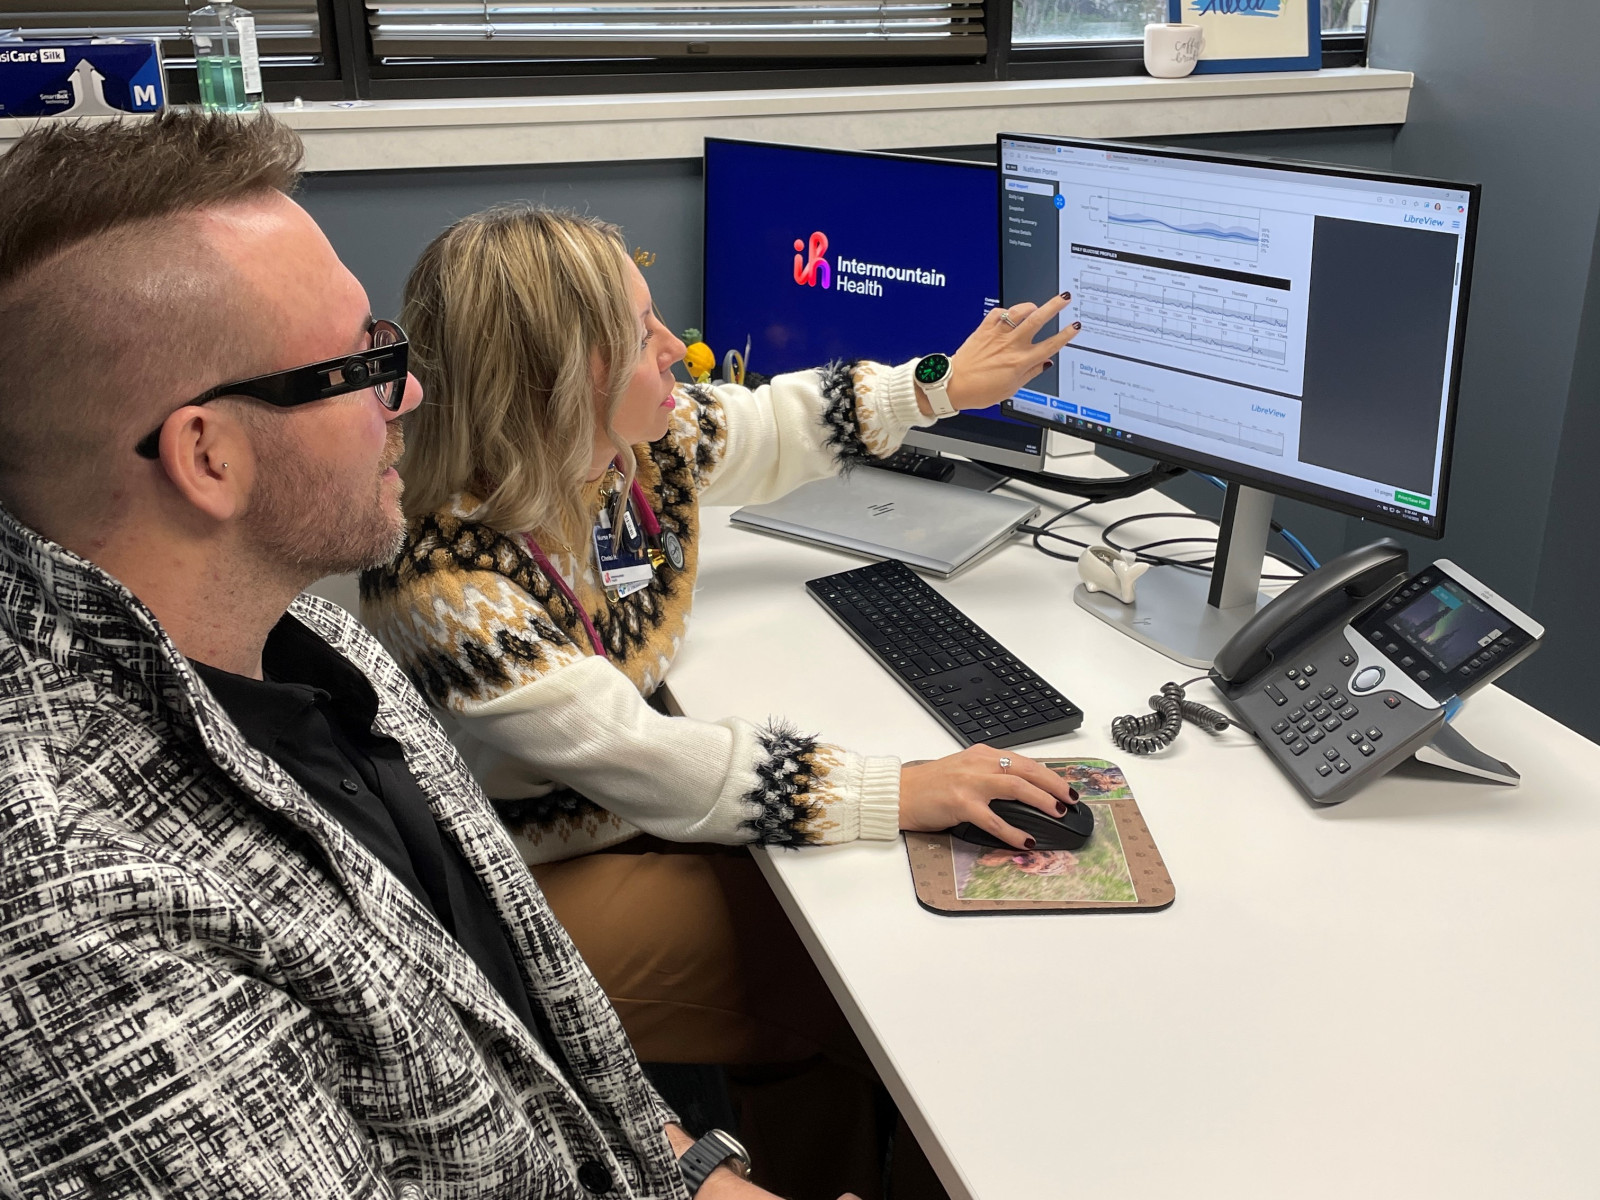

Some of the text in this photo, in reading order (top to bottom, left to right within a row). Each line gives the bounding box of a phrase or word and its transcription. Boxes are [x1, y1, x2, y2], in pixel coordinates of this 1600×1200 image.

[43, 51, 61, 60] Silk
[133, 85, 157, 106] M
[1403, 214, 1445, 227] LibreView
[838, 256, 946, 287] Intermountain
[836, 275, 883, 297] Health
[1080, 363, 1106, 376] Daily Log
[1251, 404, 1287, 418] LibreView
